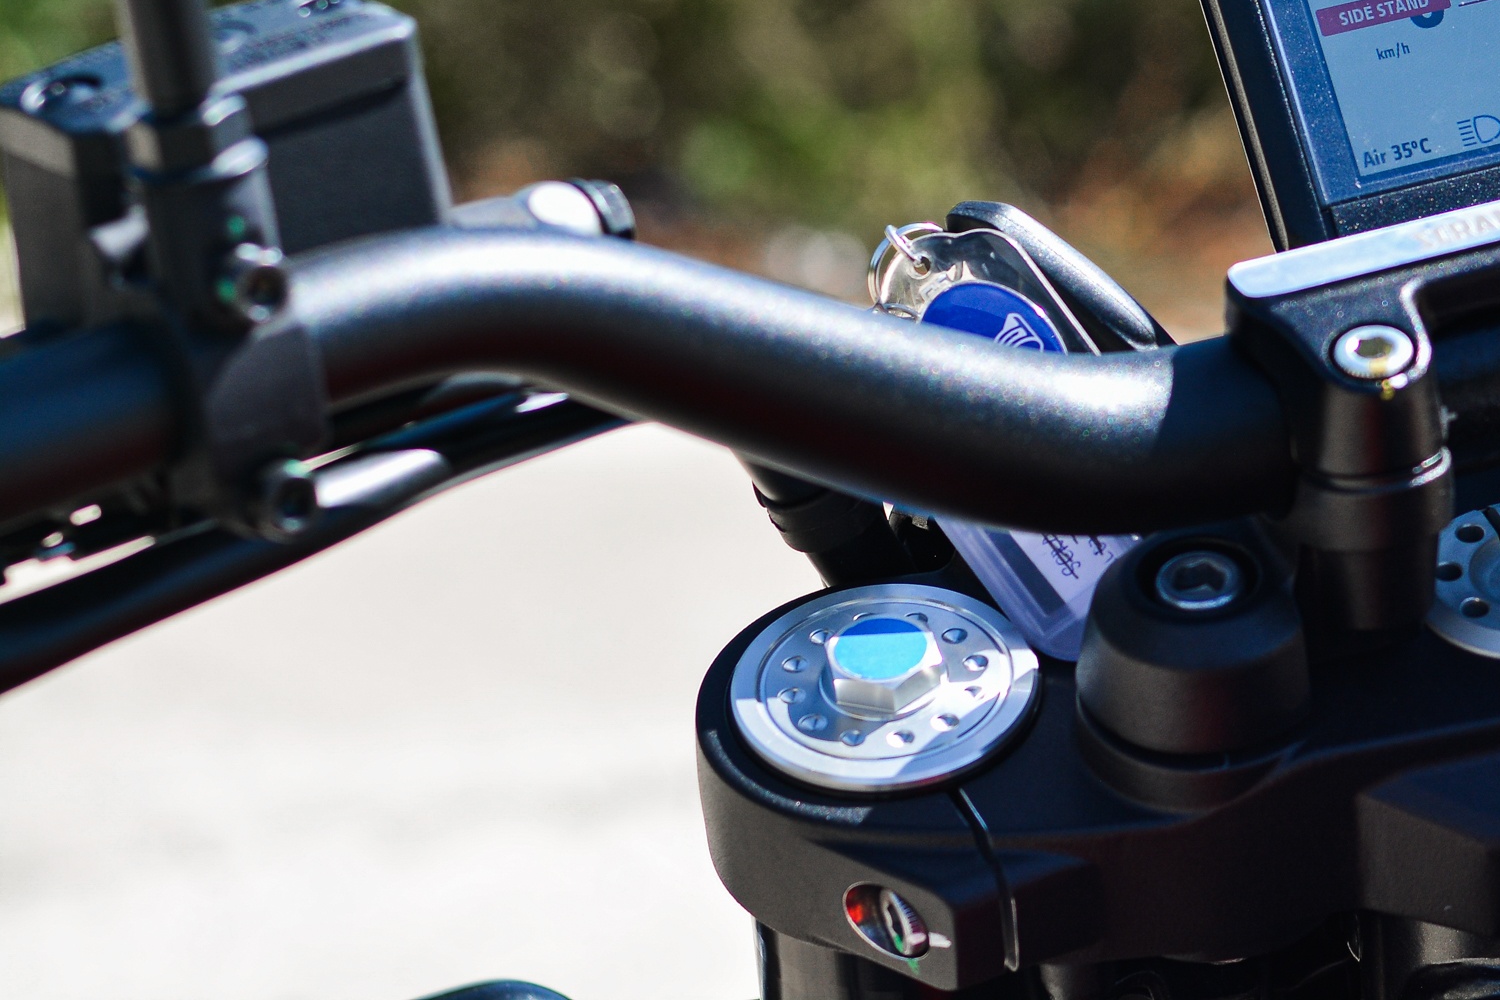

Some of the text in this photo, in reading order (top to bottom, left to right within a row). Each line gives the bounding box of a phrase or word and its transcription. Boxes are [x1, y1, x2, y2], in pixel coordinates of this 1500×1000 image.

[1339, 5, 1375, 26] SIDE
[1376, 42, 1410, 60] km/h
[1363, 147, 1386, 168] Air
